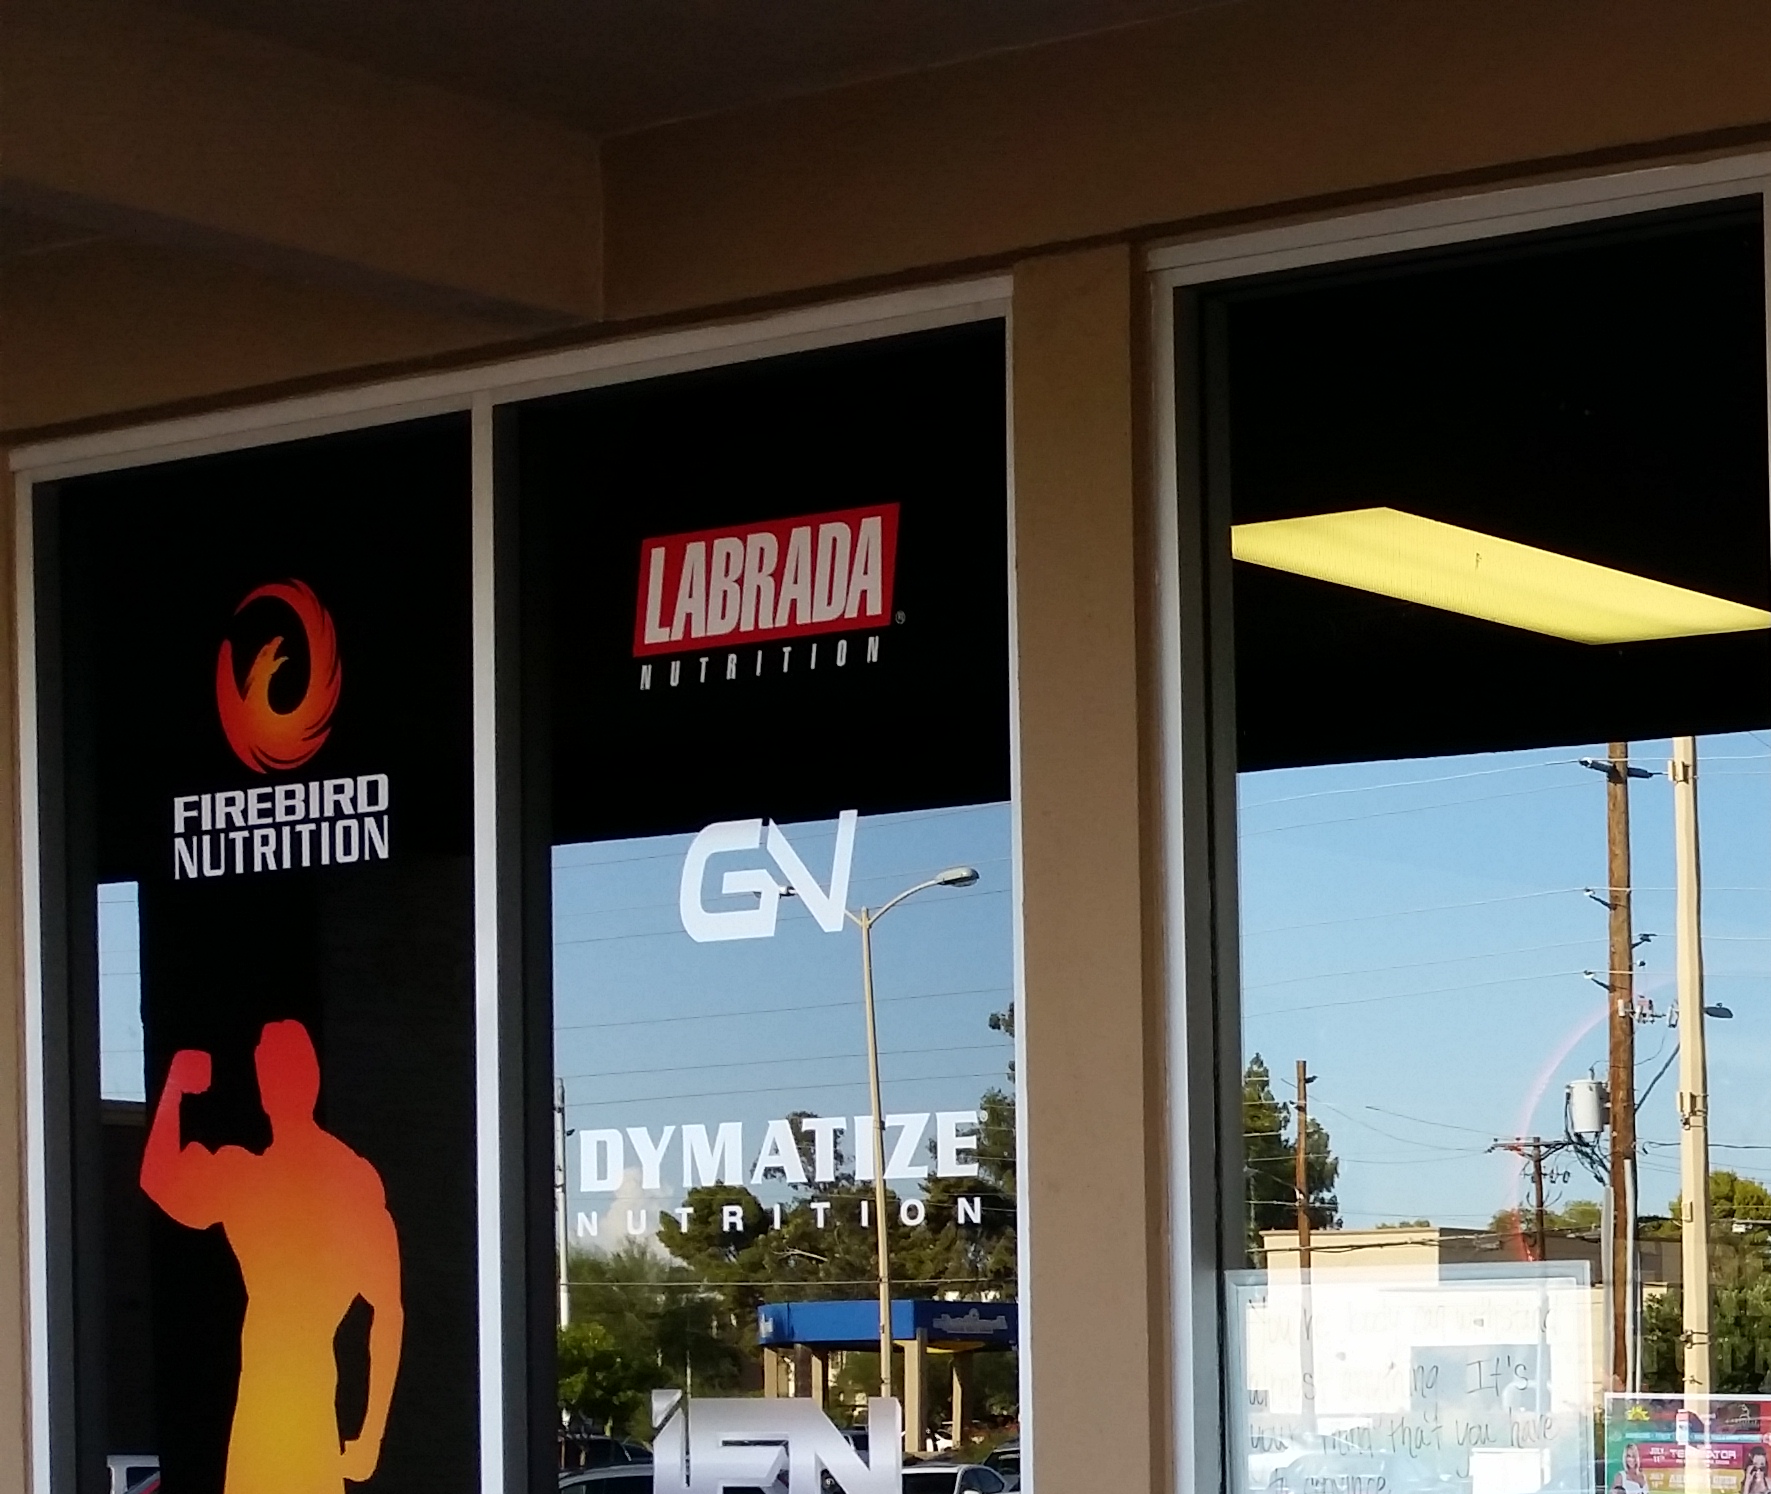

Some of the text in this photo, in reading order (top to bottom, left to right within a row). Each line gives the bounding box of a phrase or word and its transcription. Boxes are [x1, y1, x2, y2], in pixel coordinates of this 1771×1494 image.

[641, 515, 886, 644] LABRADA
[640, 635, 882, 691] NUTRITION
[174, 773, 390, 833] FIREBIRD
[174, 815, 390, 880] NUTRITION
[679, 809, 857, 943] GN
[580, 1110, 981, 1193] DYMATIZE
[577, 1197, 982, 1237] NUTRITION
